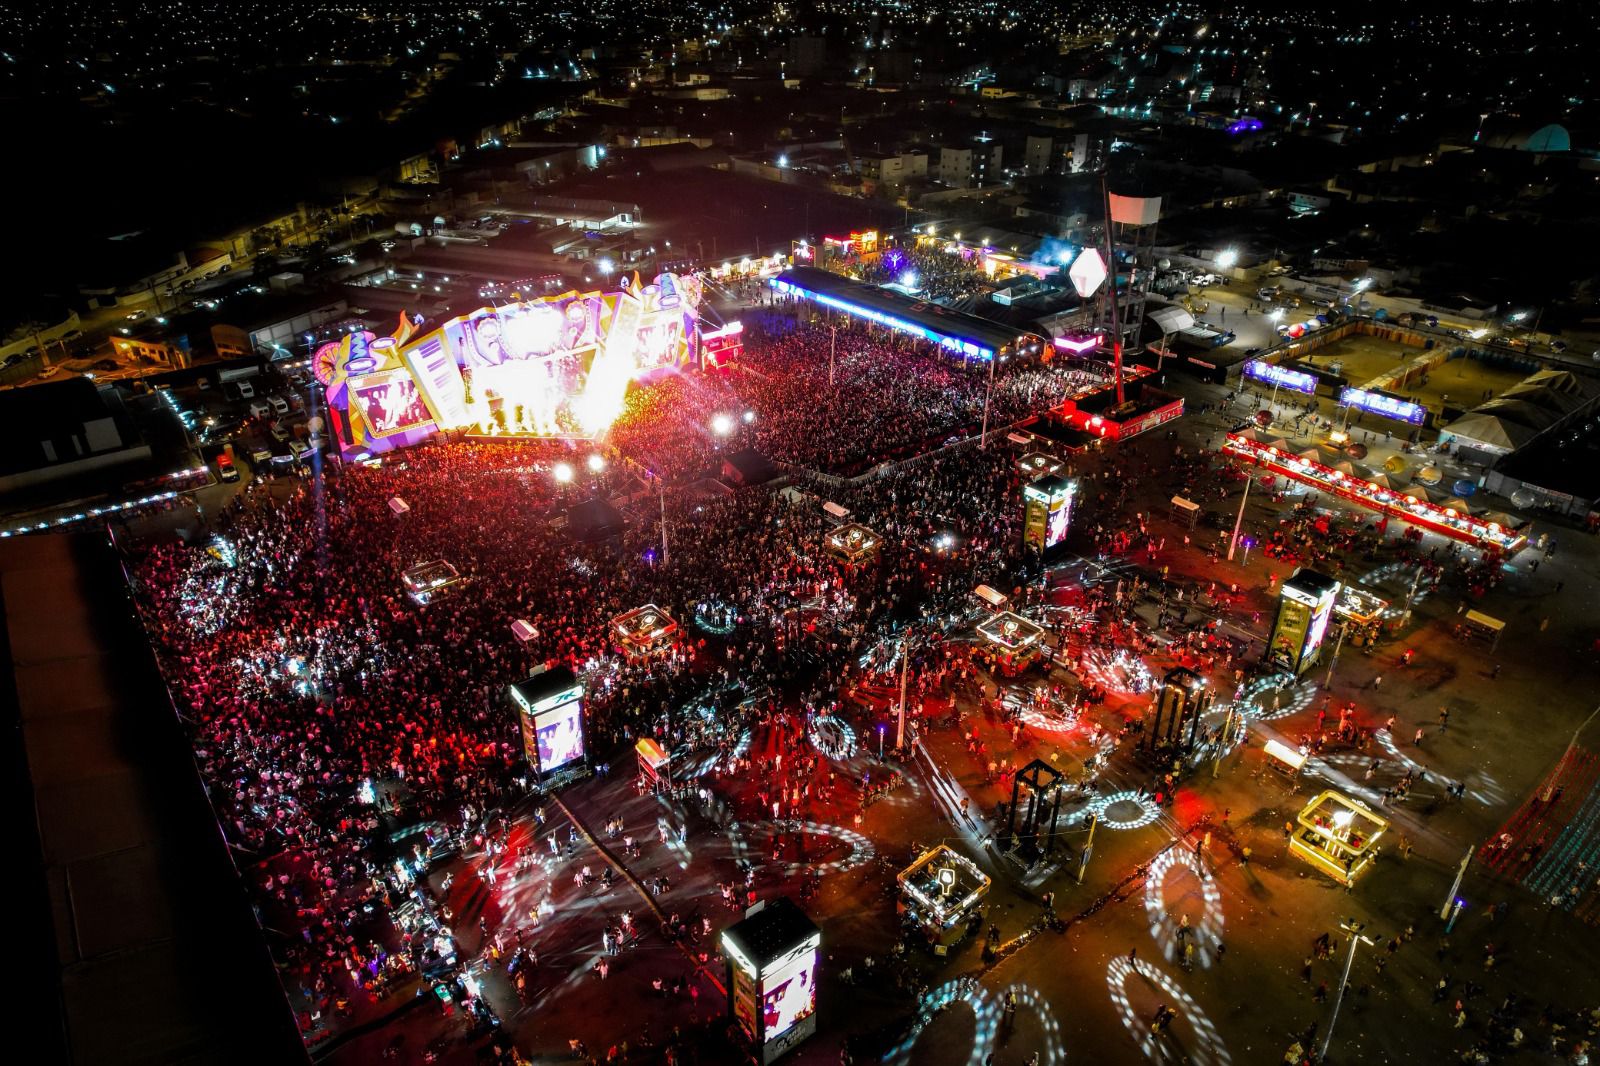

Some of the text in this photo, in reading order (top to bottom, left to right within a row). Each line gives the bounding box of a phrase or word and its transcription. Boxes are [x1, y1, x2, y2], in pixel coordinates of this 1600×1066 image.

[1296, 593, 1313, 604] 7K
[555, 690, 577, 704] 7K
[786, 941, 812, 961] 7K
